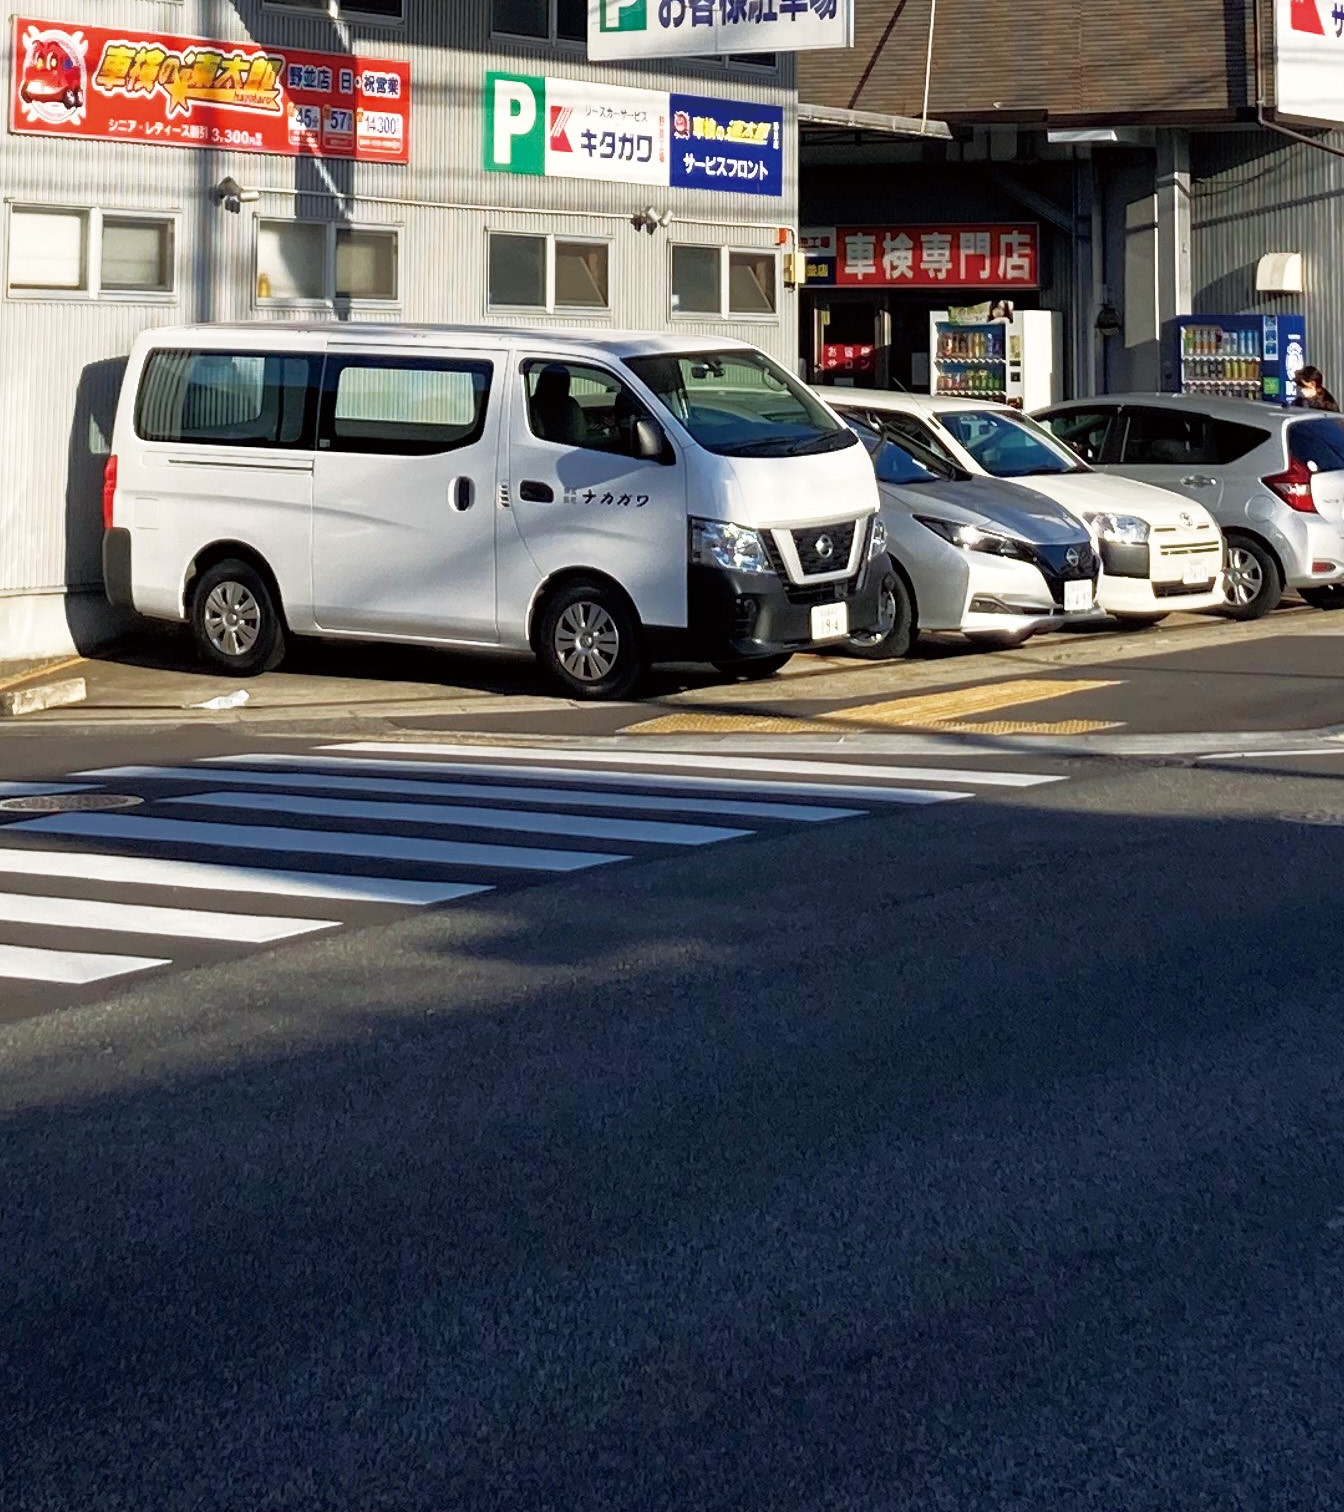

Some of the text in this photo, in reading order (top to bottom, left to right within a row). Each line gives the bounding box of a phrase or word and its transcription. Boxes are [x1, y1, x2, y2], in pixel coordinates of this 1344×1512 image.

[98, 45, 284, 96] 車検の速太郎
[494, 79, 536, 164] P
[581, 128, 653, 163] キタガワ
[683, 152, 769, 181] サービスフロント
[844, 230, 1032, 280] 車検専門店
[582, 489, 650, 507] ナカガワ
